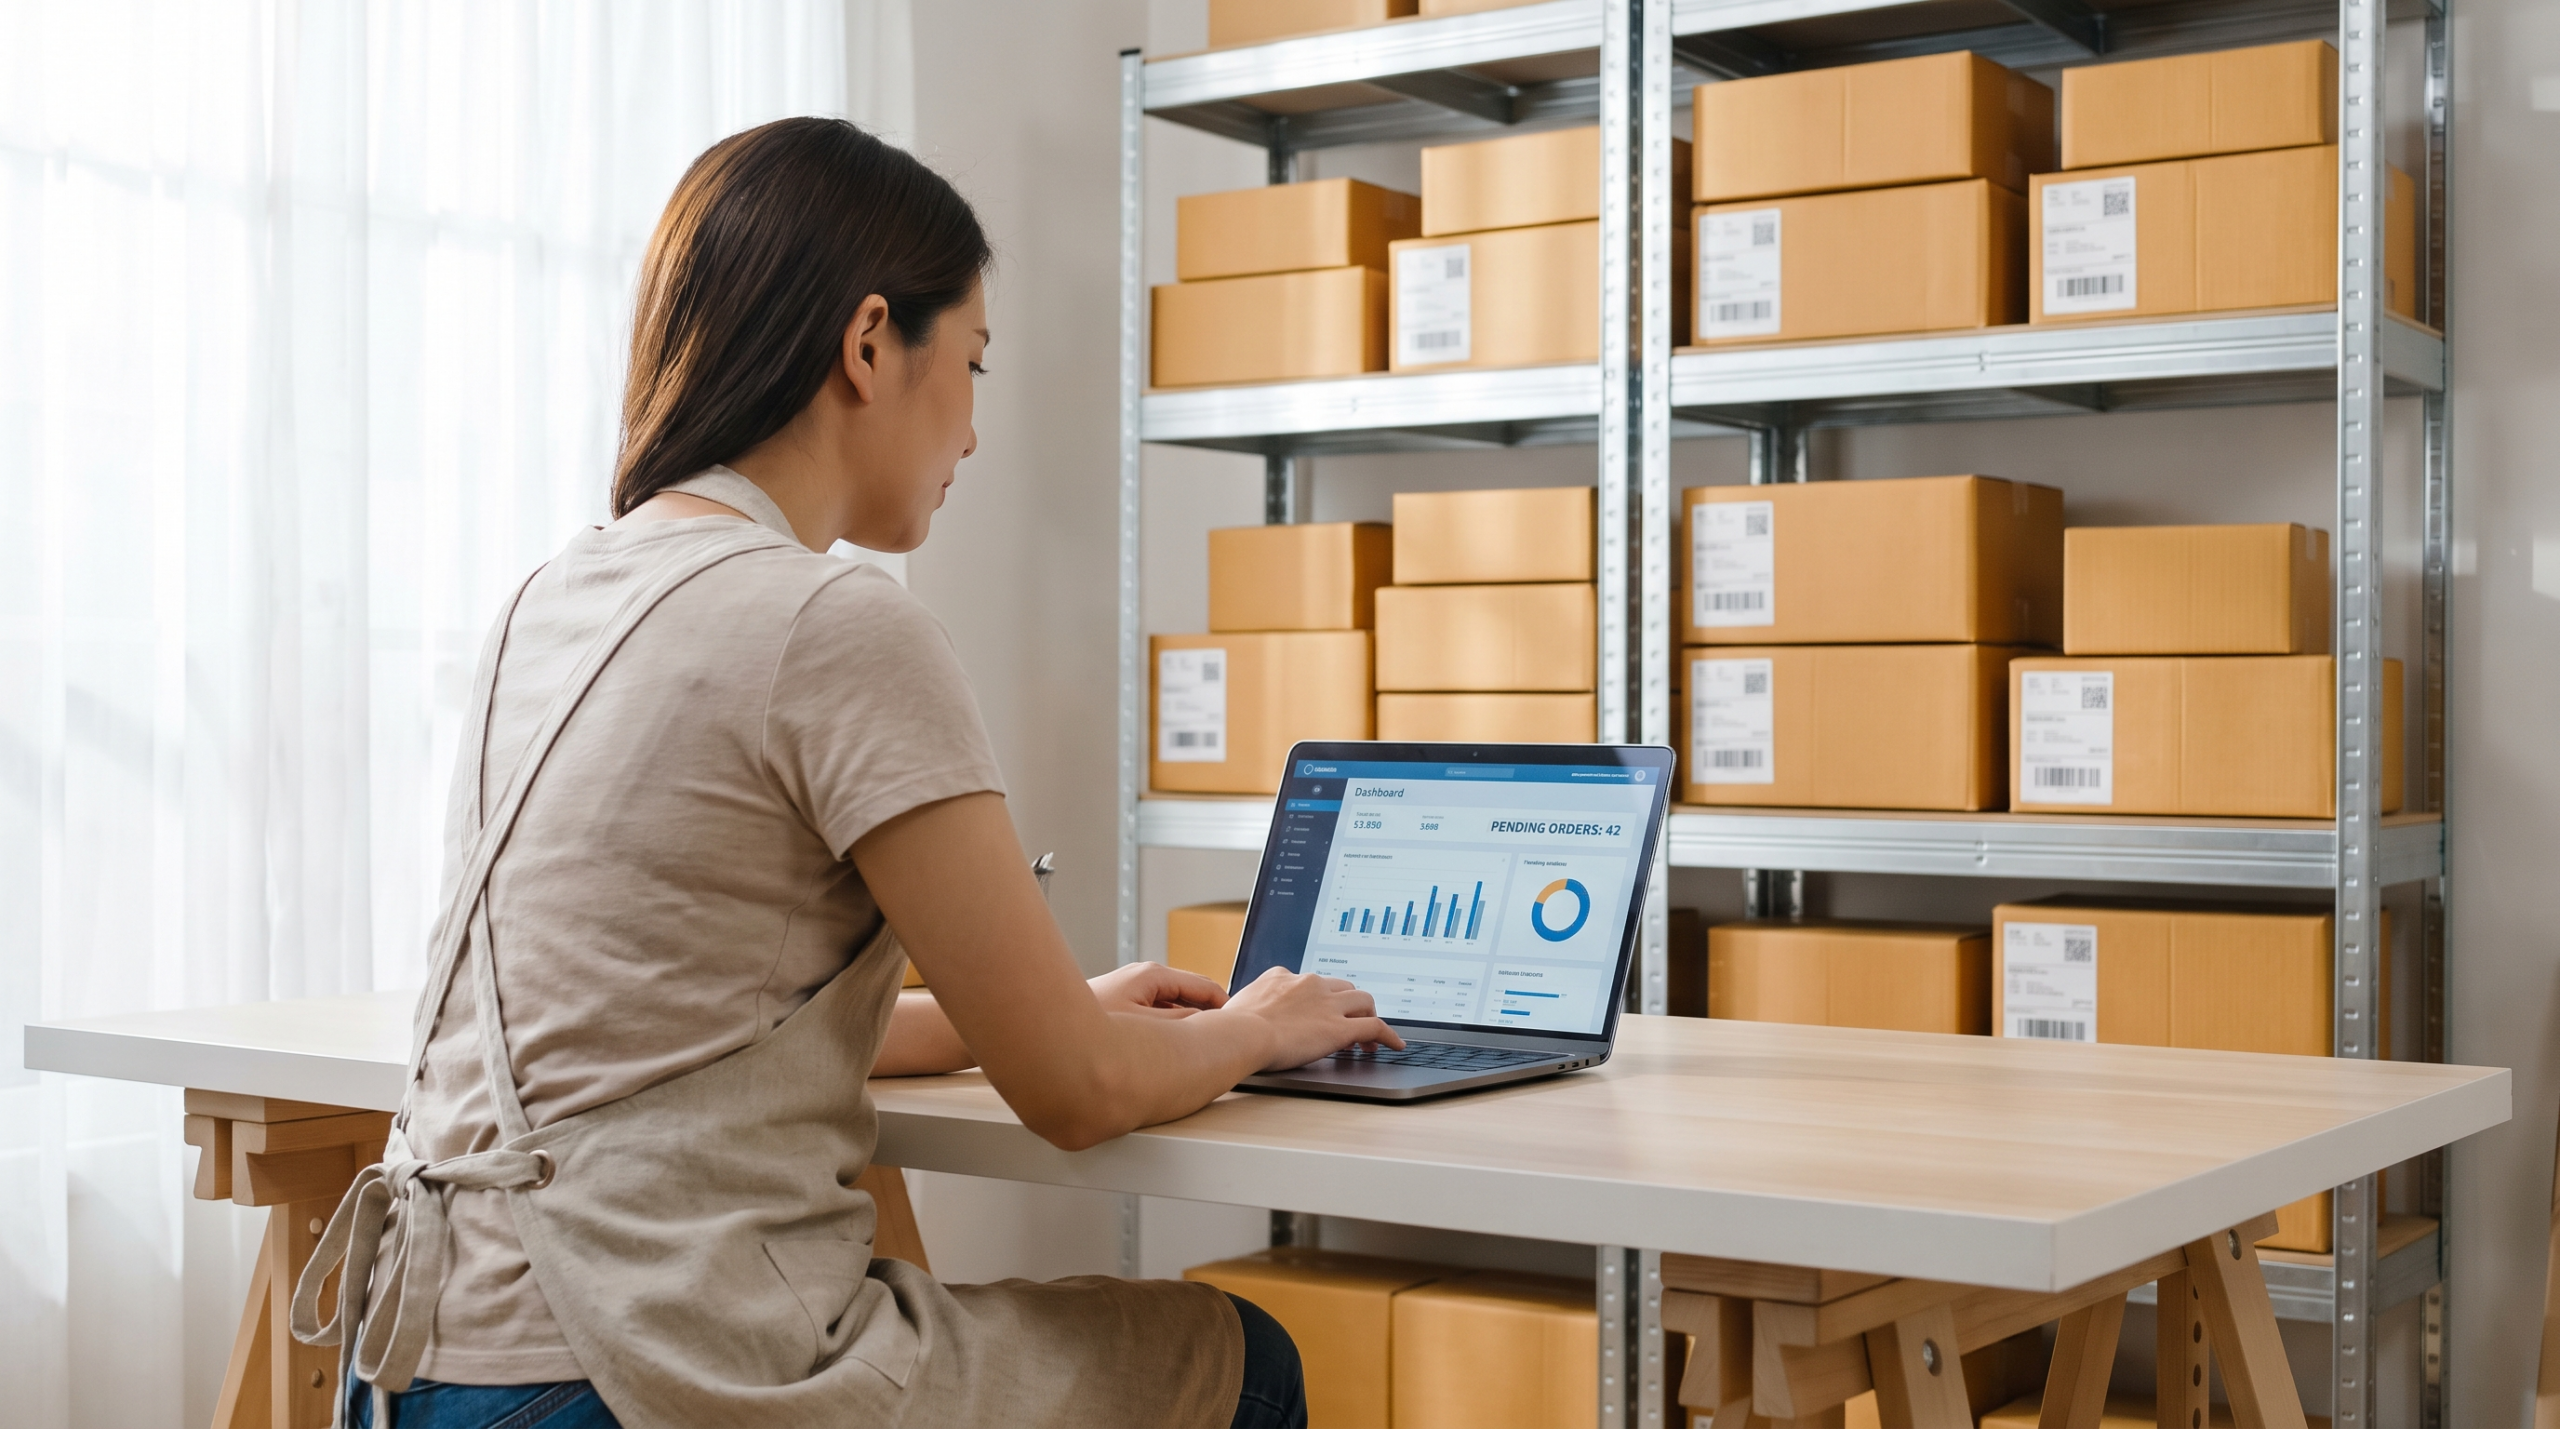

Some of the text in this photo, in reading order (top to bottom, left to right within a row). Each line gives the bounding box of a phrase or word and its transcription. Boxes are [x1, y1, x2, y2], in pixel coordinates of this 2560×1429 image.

[1355, 787, 1405, 798] Dashboard
[1490, 821, 1622, 836] PENDING ORDERS: 42
